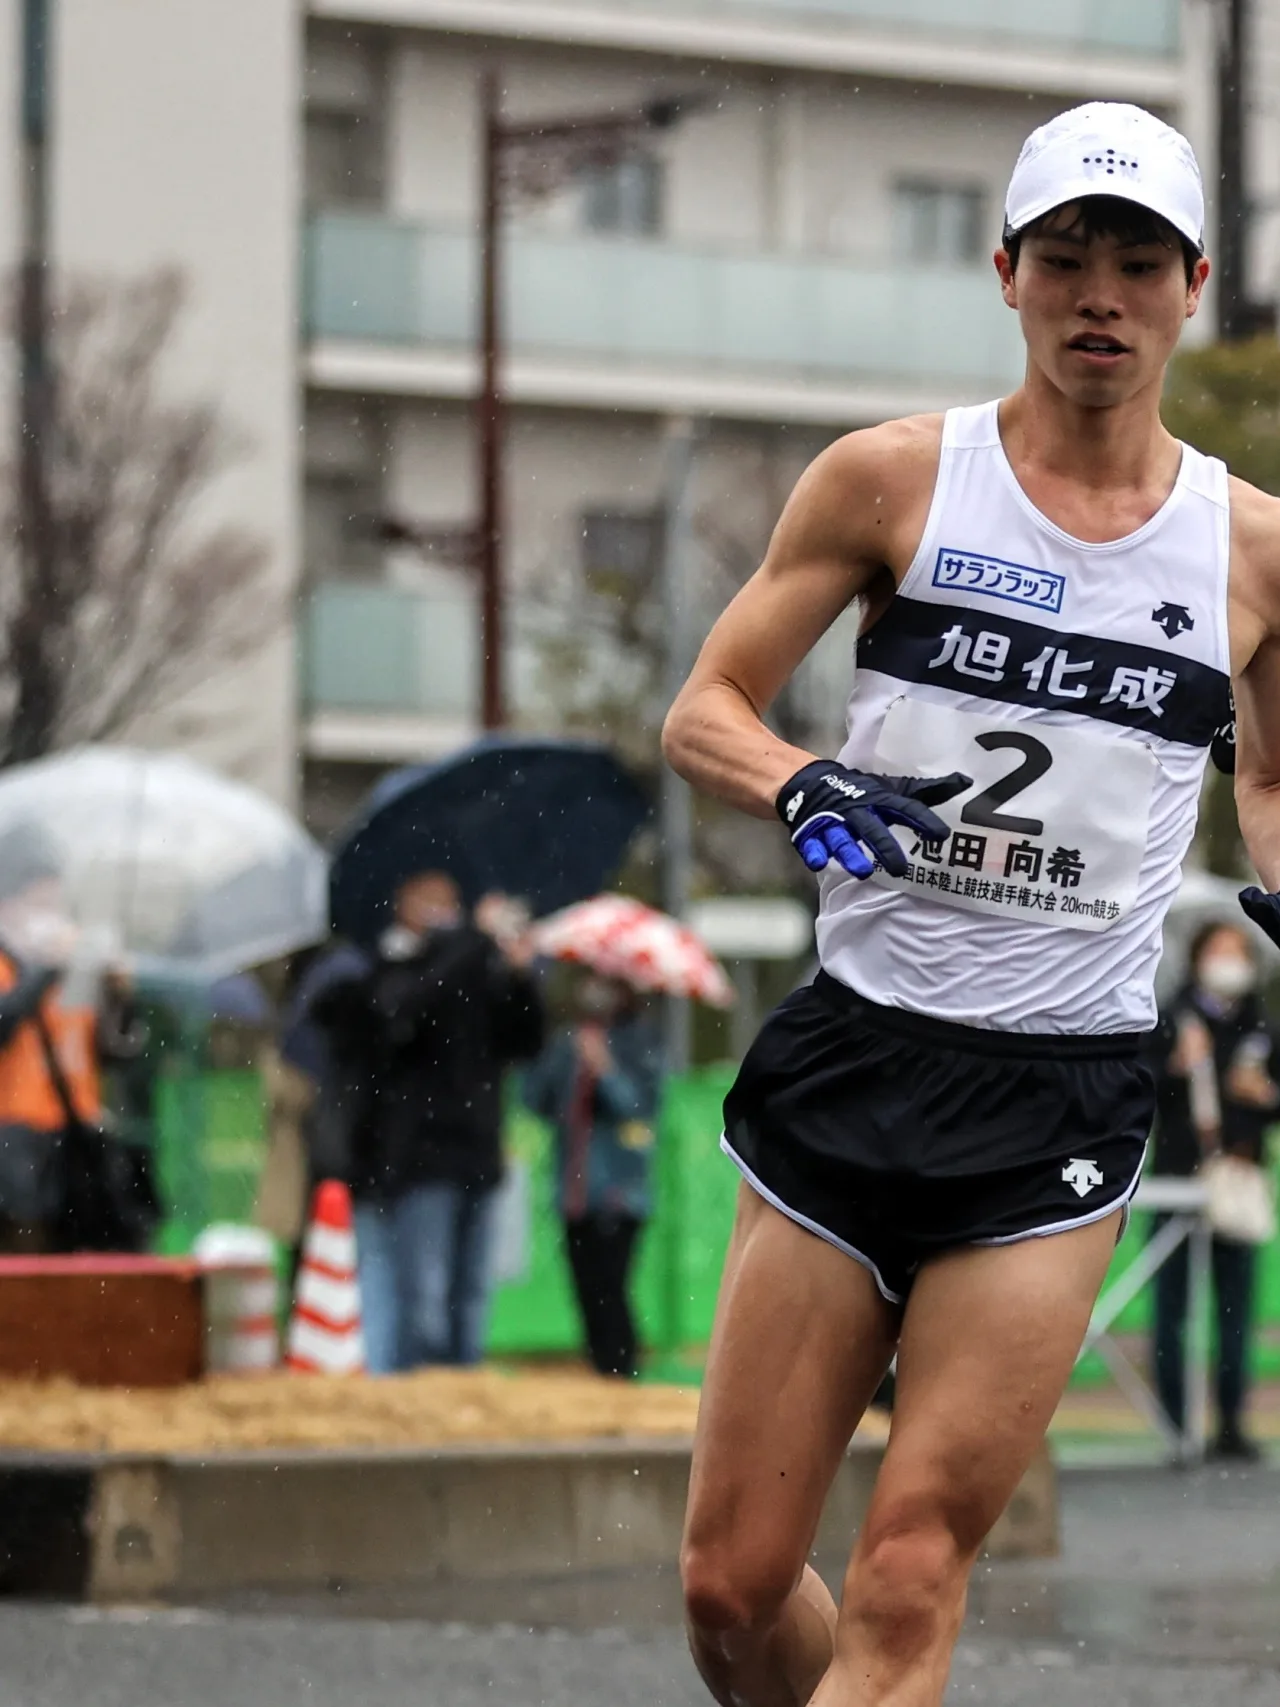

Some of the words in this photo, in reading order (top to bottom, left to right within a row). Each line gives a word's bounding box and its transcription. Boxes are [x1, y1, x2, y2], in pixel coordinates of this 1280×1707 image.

[928, 624, 1178, 719] 旭化成
[961, 731, 1053, 836] 2
[1003, 840, 1085, 888] 向希
[1060, 895, 1120, 921] 20km競歩
